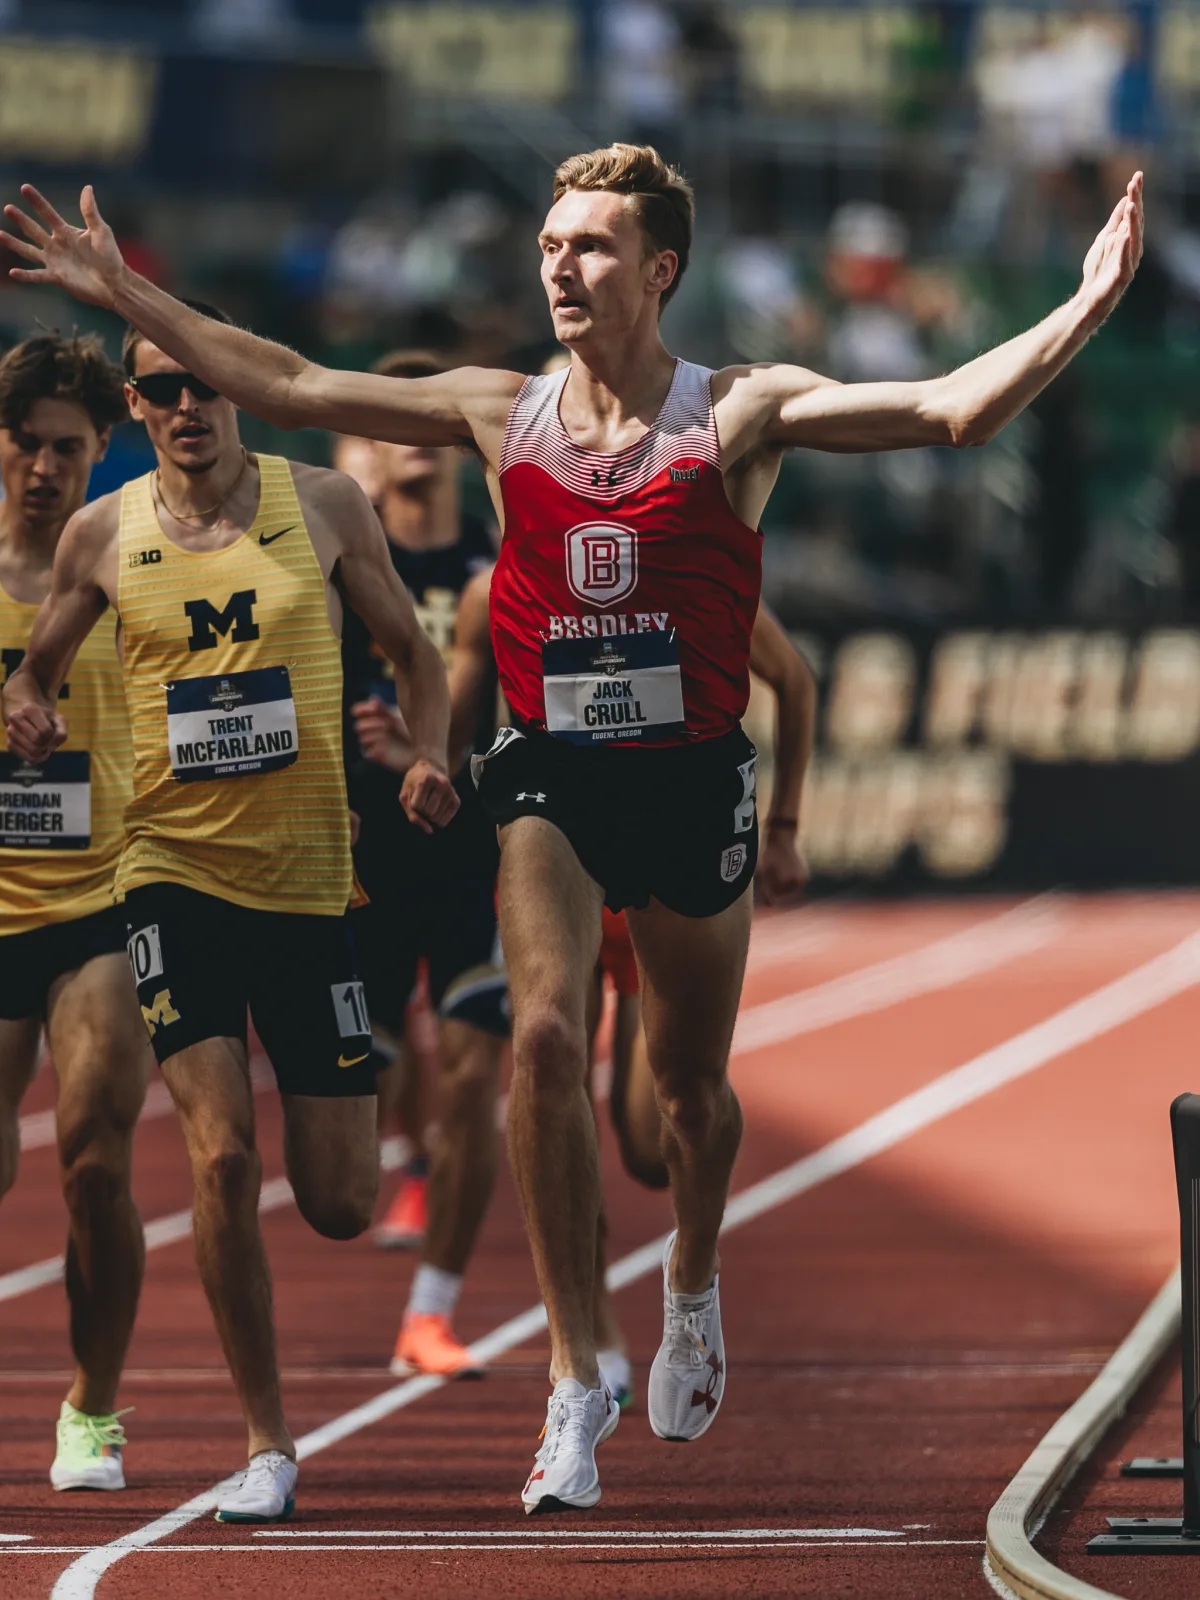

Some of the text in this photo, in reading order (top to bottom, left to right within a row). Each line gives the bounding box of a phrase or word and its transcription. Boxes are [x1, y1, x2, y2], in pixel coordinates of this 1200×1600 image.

[668, 464, 701, 482] VALLEY
[581, 536, 621, 590] B
[184, 588, 260, 652] M
[549, 612, 669, 641] BRADLEY
[593, 681, 634, 700] JACK
[208, 715, 254, 736] TRENT
[584, 701, 647, 727] CRULL
[176, 729, 294, 765] MCFARLAND
[592, 729, 642, 740] EUGENE, OREGON
[214, 761, 262, 774] EUGENE, OREGON
[141, 988, 181, 1038] M
